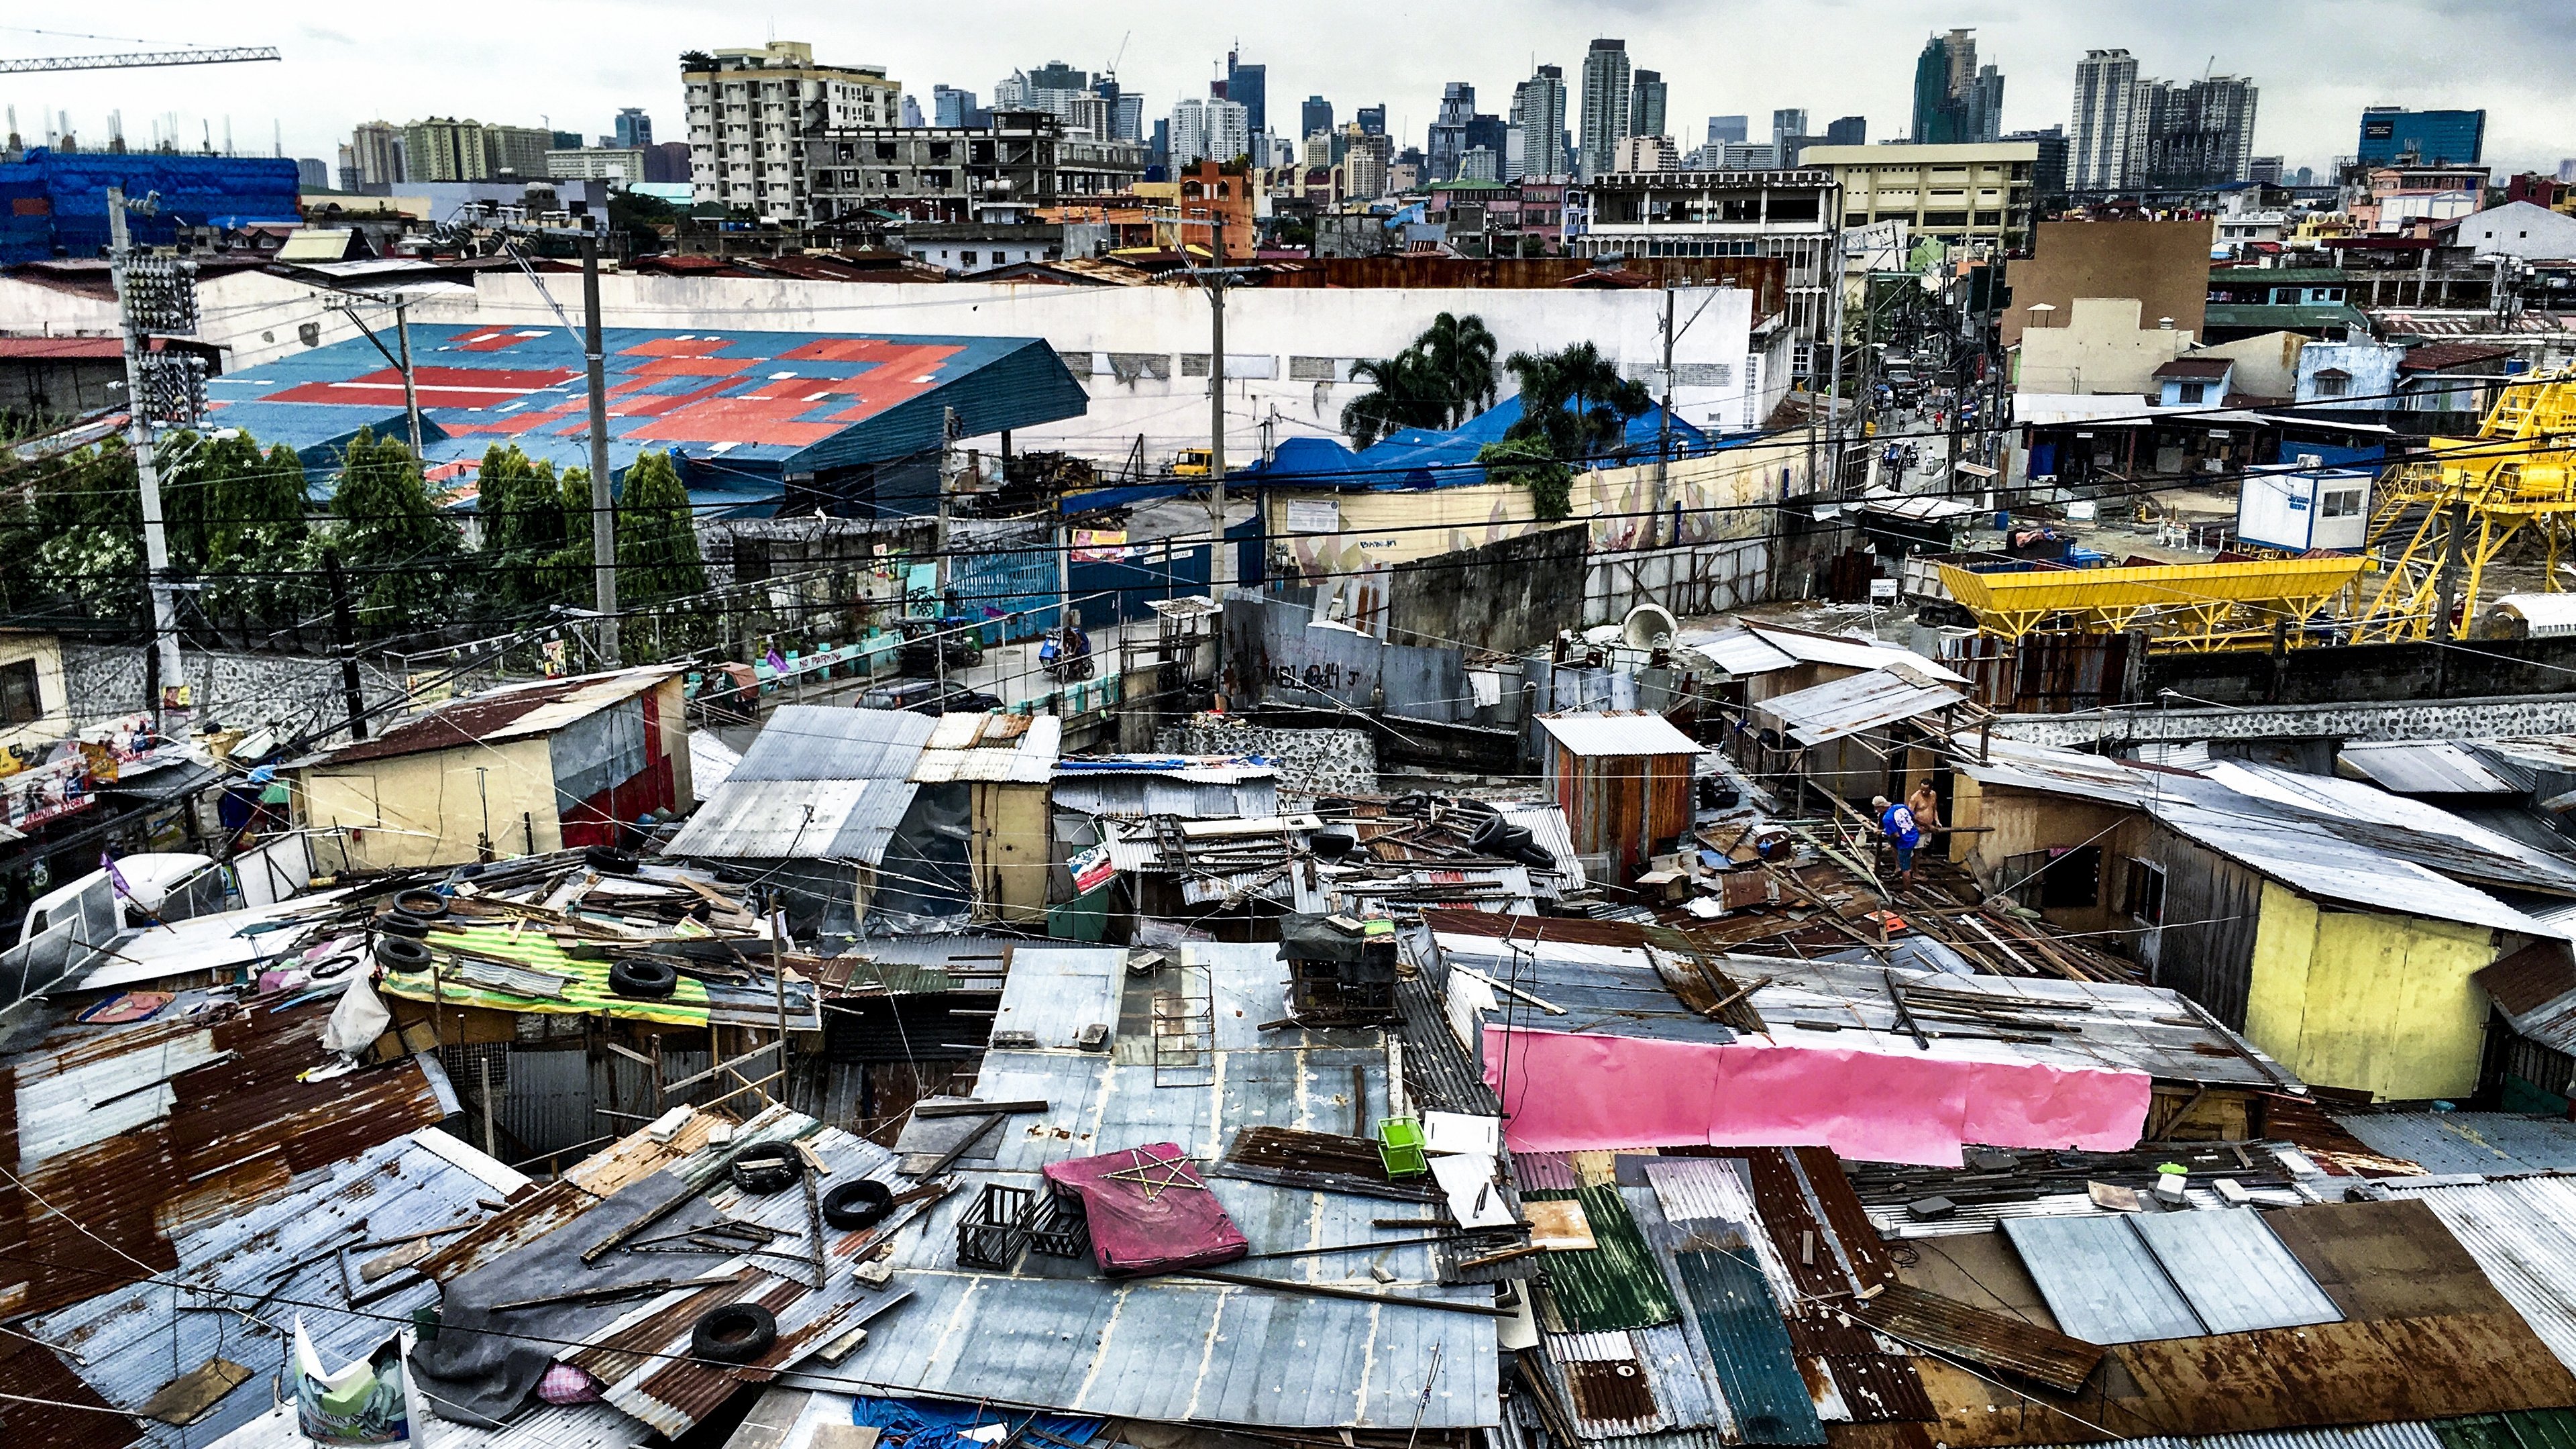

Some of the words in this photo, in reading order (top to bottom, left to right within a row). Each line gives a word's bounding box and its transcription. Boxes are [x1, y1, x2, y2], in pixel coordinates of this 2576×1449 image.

[799, 659, 809, 667] NO
[811, 652, 842, 665] PARKING
[61, 797, 86, 812] STORE
